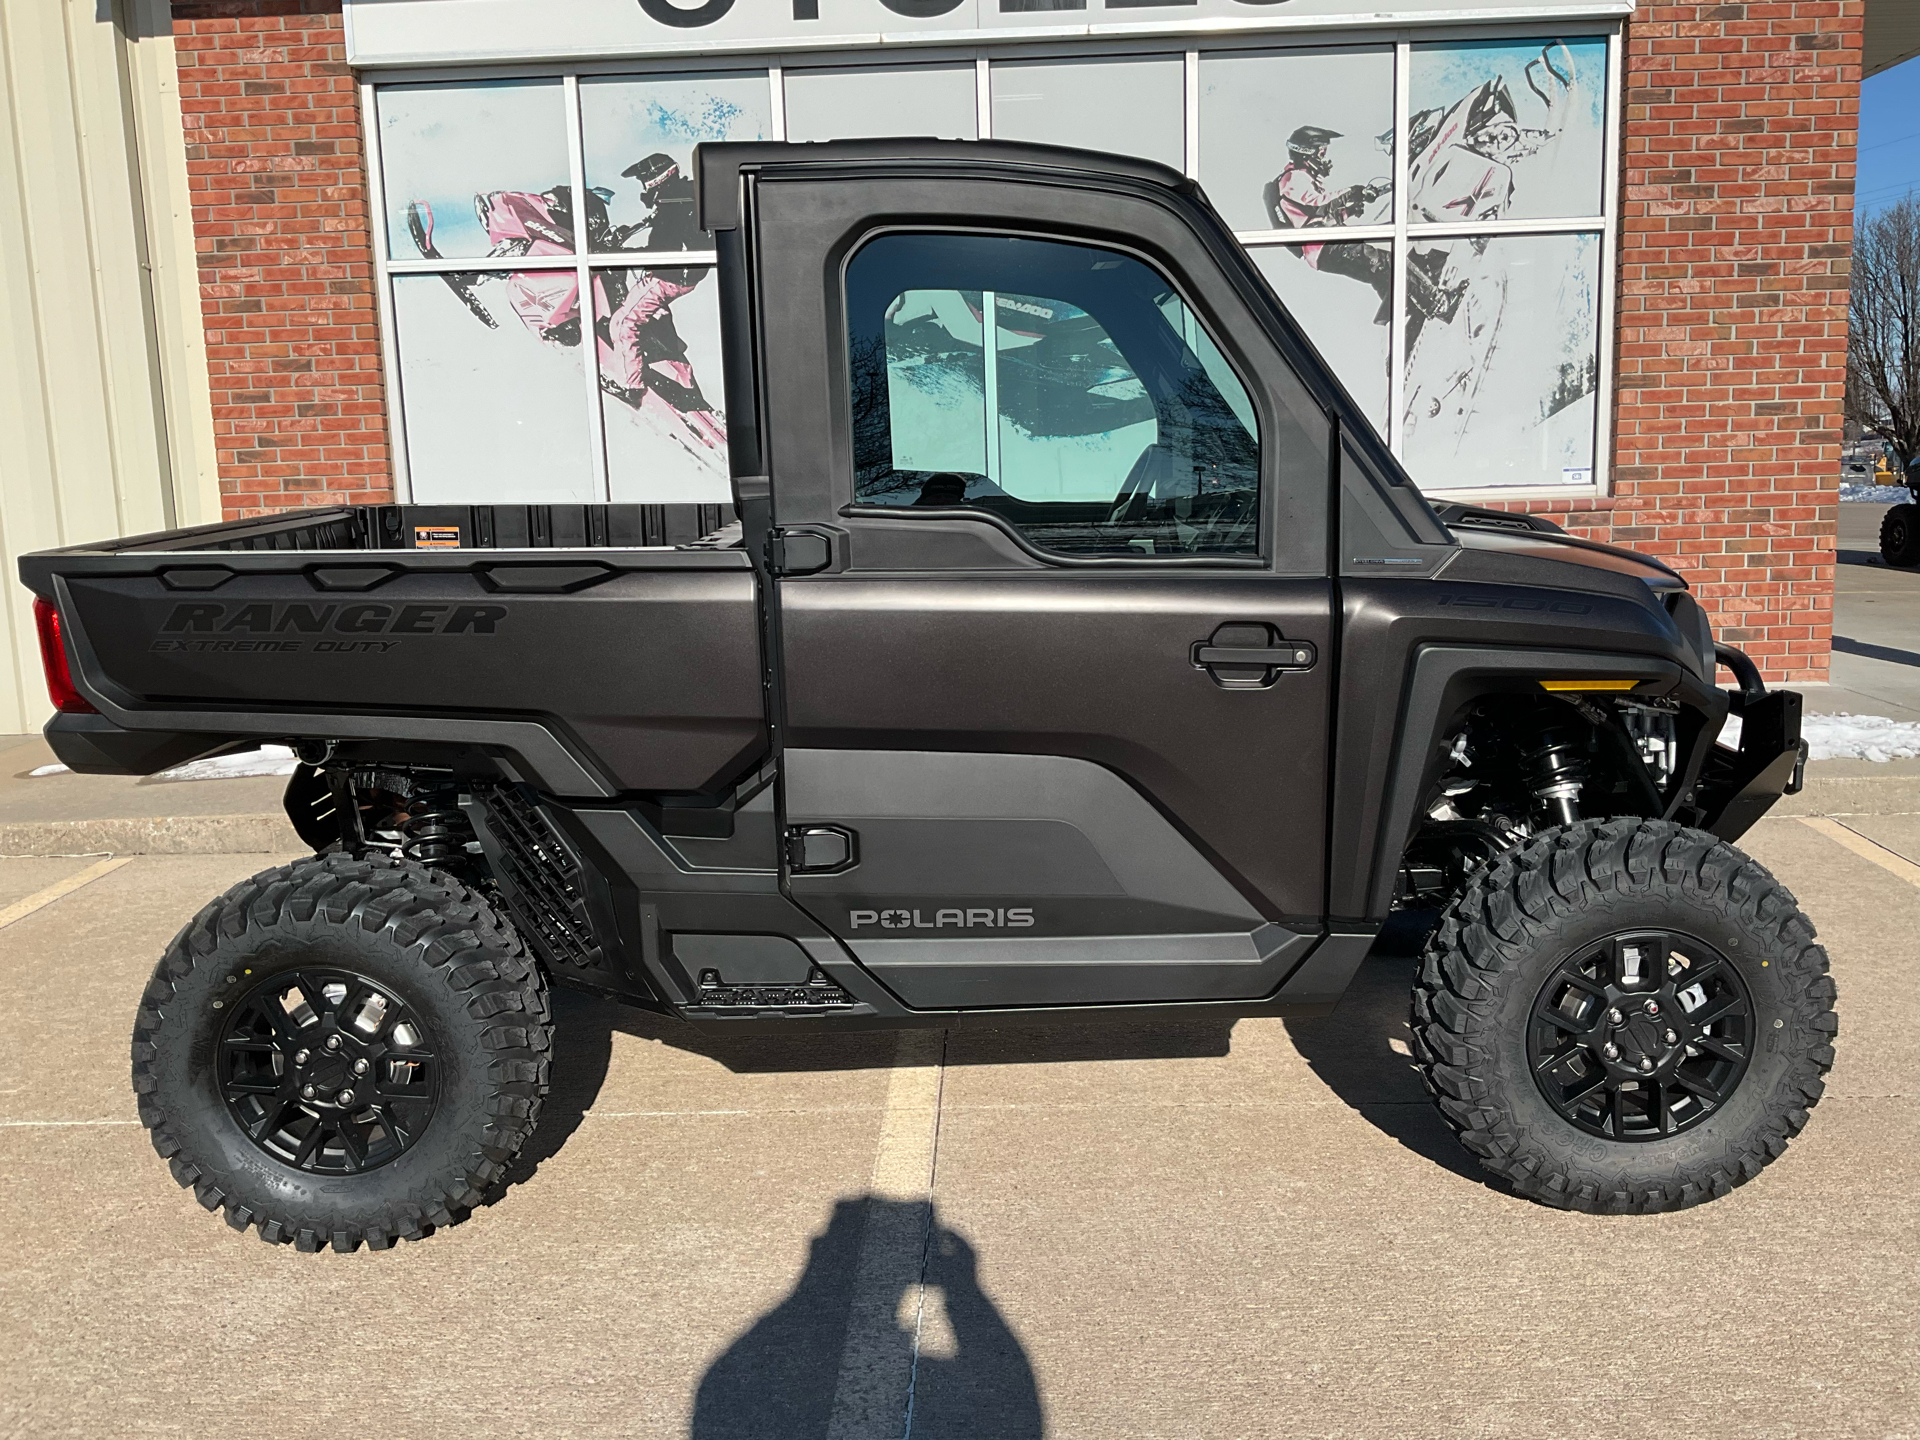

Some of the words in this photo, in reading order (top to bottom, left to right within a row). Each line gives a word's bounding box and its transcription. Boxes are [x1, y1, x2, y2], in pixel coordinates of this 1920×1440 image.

[1438, 594, 1594, 616] 1500
[159, 602, 509, 635] RANGER
[149, 640, 302, 652] EXTREME
[312, 640, 401, 653] DUTY
[850, 908, 1035, 928] POLARIS
